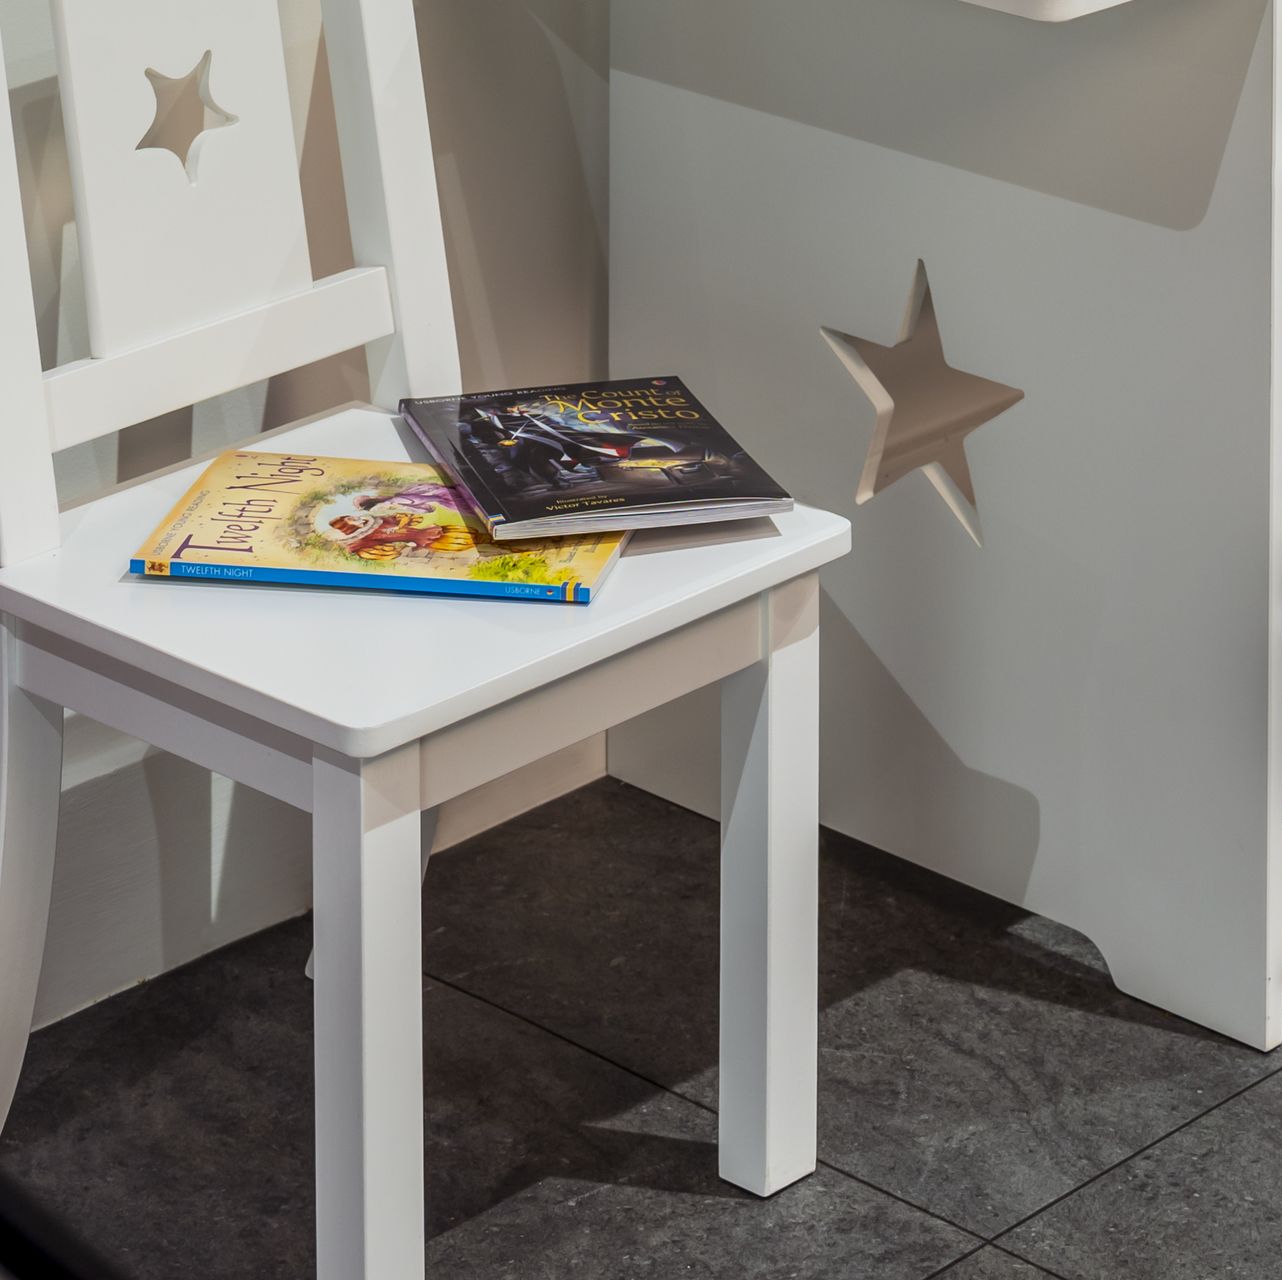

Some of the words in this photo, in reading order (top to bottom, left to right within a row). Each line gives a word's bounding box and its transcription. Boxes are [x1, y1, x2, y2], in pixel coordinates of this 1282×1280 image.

[580, 387, 660, 400] Count
[549, 396, 692, 415] Monte
[576, 405, 700, 425] Cristo
[225, 455, 326, 496] Night
[545, 502, 581, 511] Victor
[581, 498, 626, 507] Tavares
[170, 498, 283, 560] Twelfth
[181, 564, 221, 576] TWELFTH
[223, 568, 254, 578] NIGHT
[504, 586, 541, 596] USBORNE
